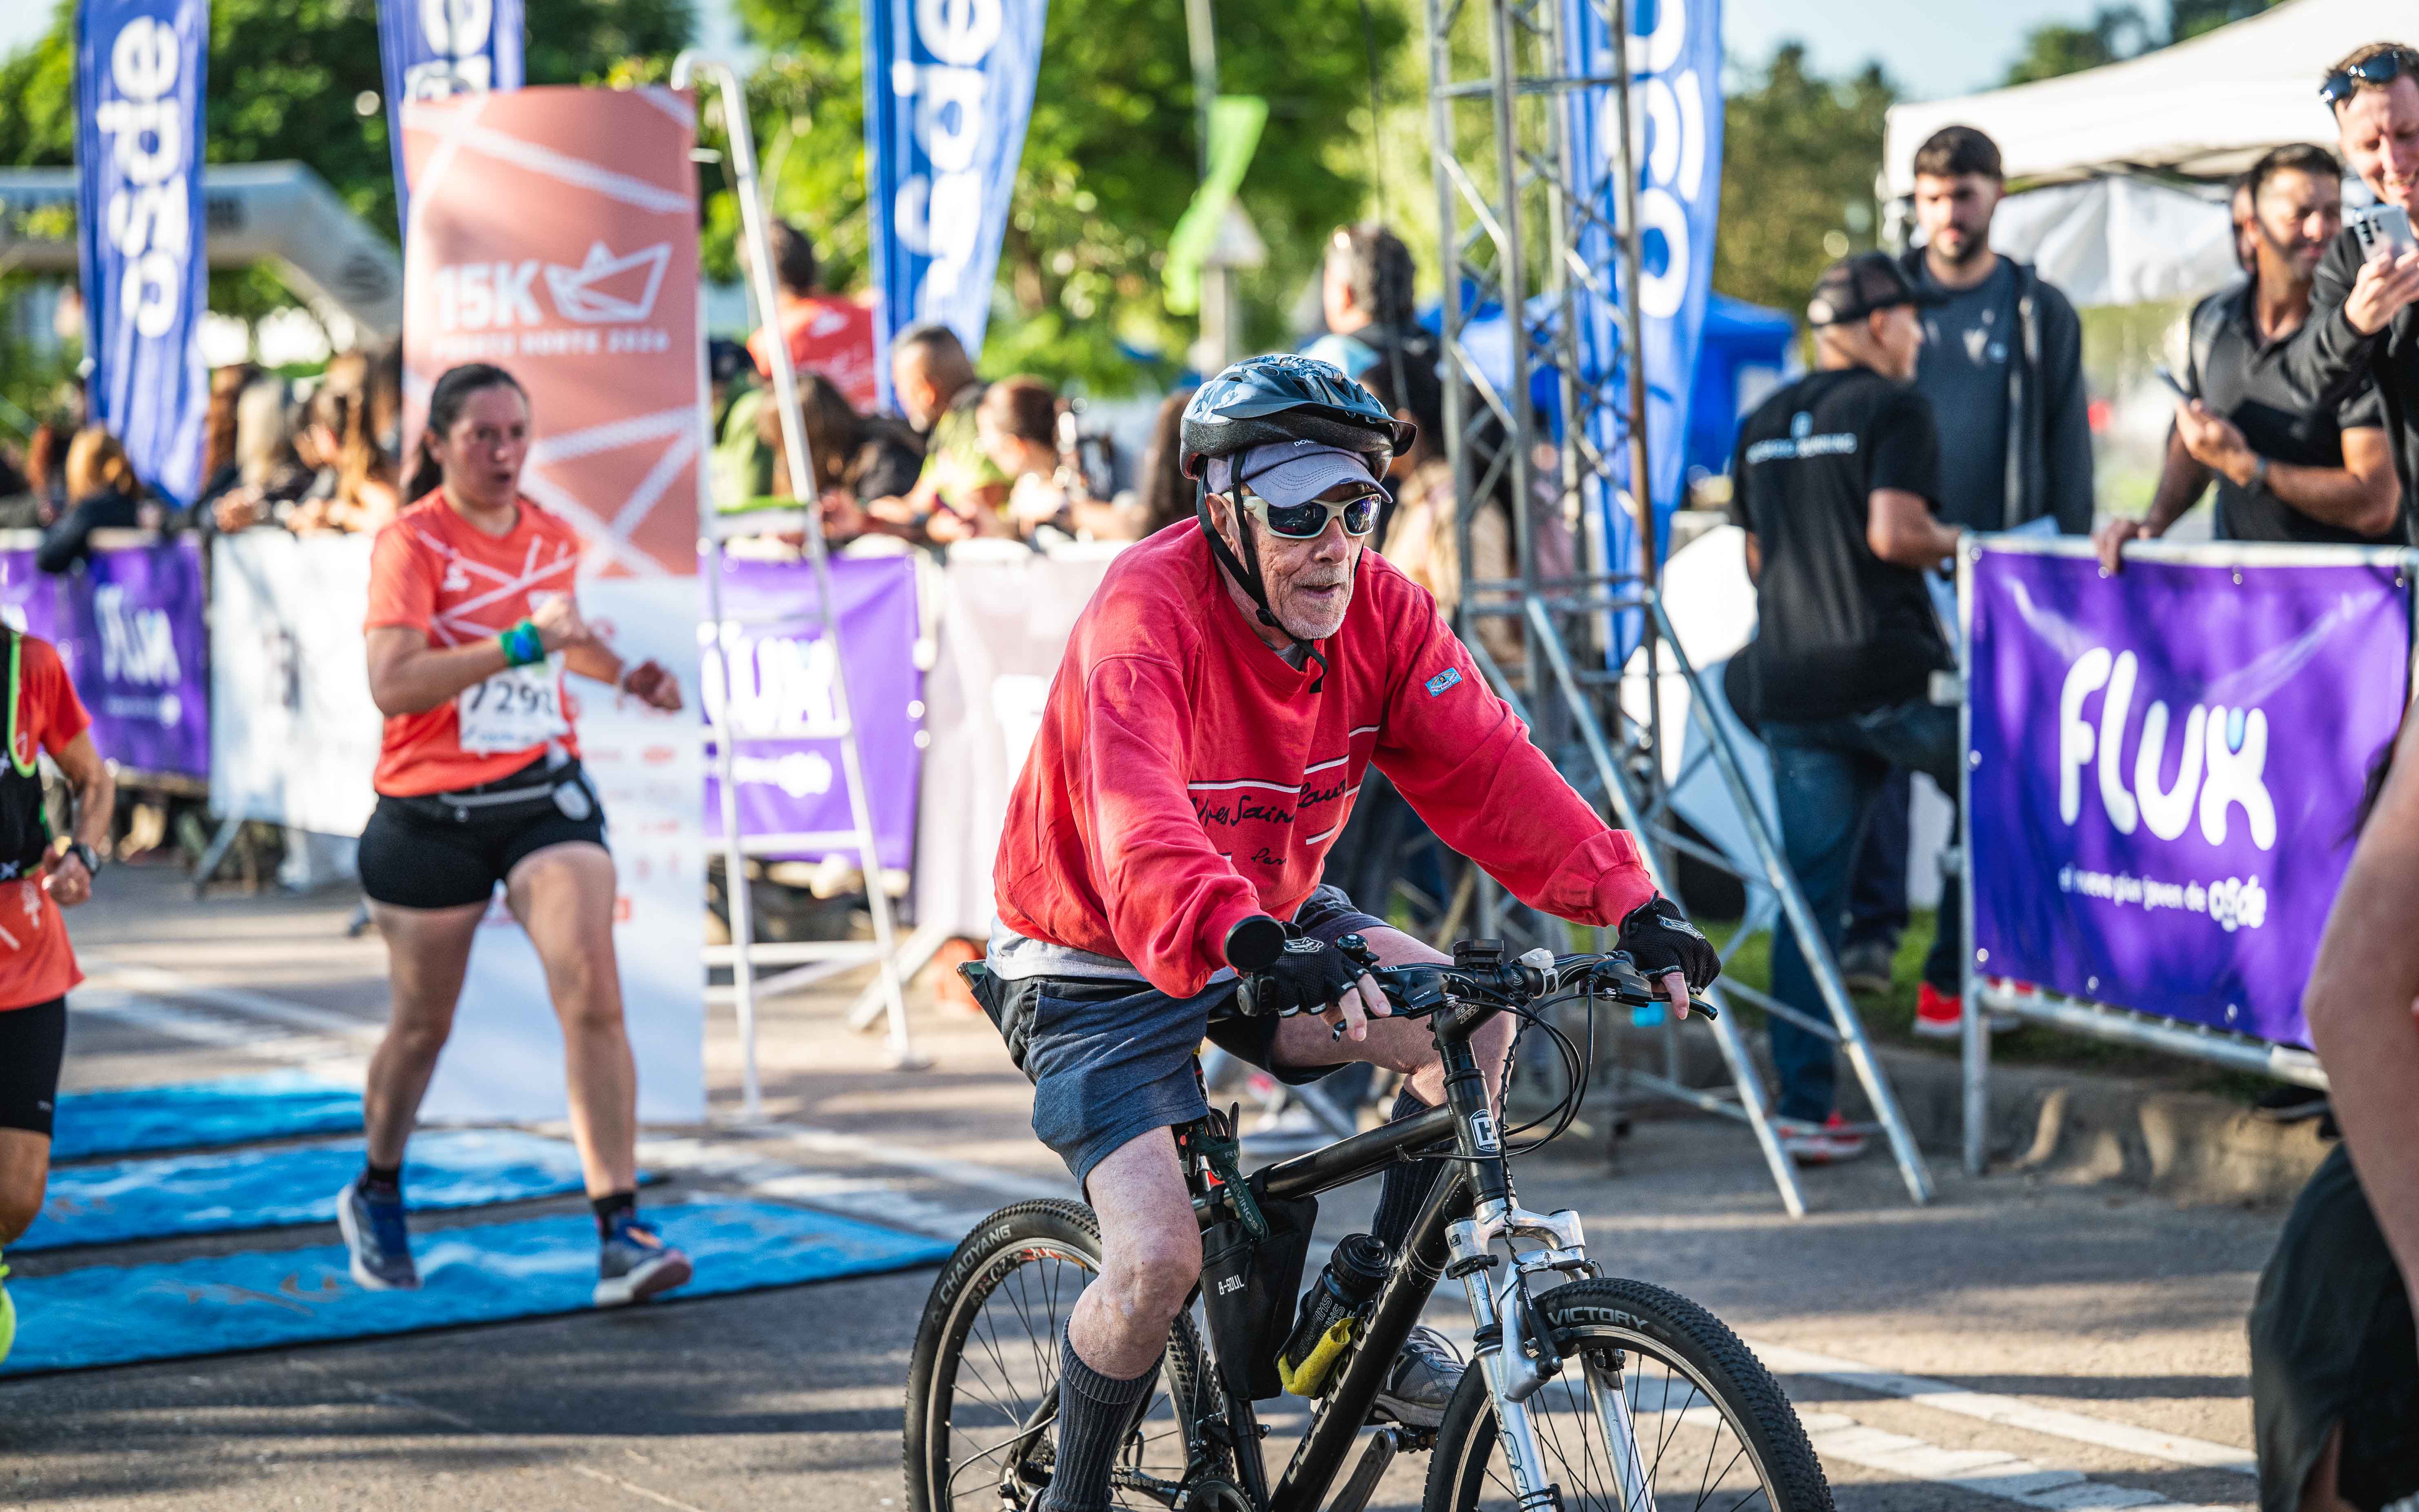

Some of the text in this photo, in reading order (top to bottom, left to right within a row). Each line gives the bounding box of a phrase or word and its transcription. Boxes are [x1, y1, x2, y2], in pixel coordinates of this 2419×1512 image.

[96, 14, 188, 337] osde
[435, 261, 543, 331] 15K
[1230, 795, 1296, 827] Sain
[1297, 777, 1347, 808] Laur
[940, 1224, 1012, 1305] CHAOYANG
[1218, 1274, 1244, 1295] B-SOUL
[1548, 1306, 1649, 1330] VICTORY
